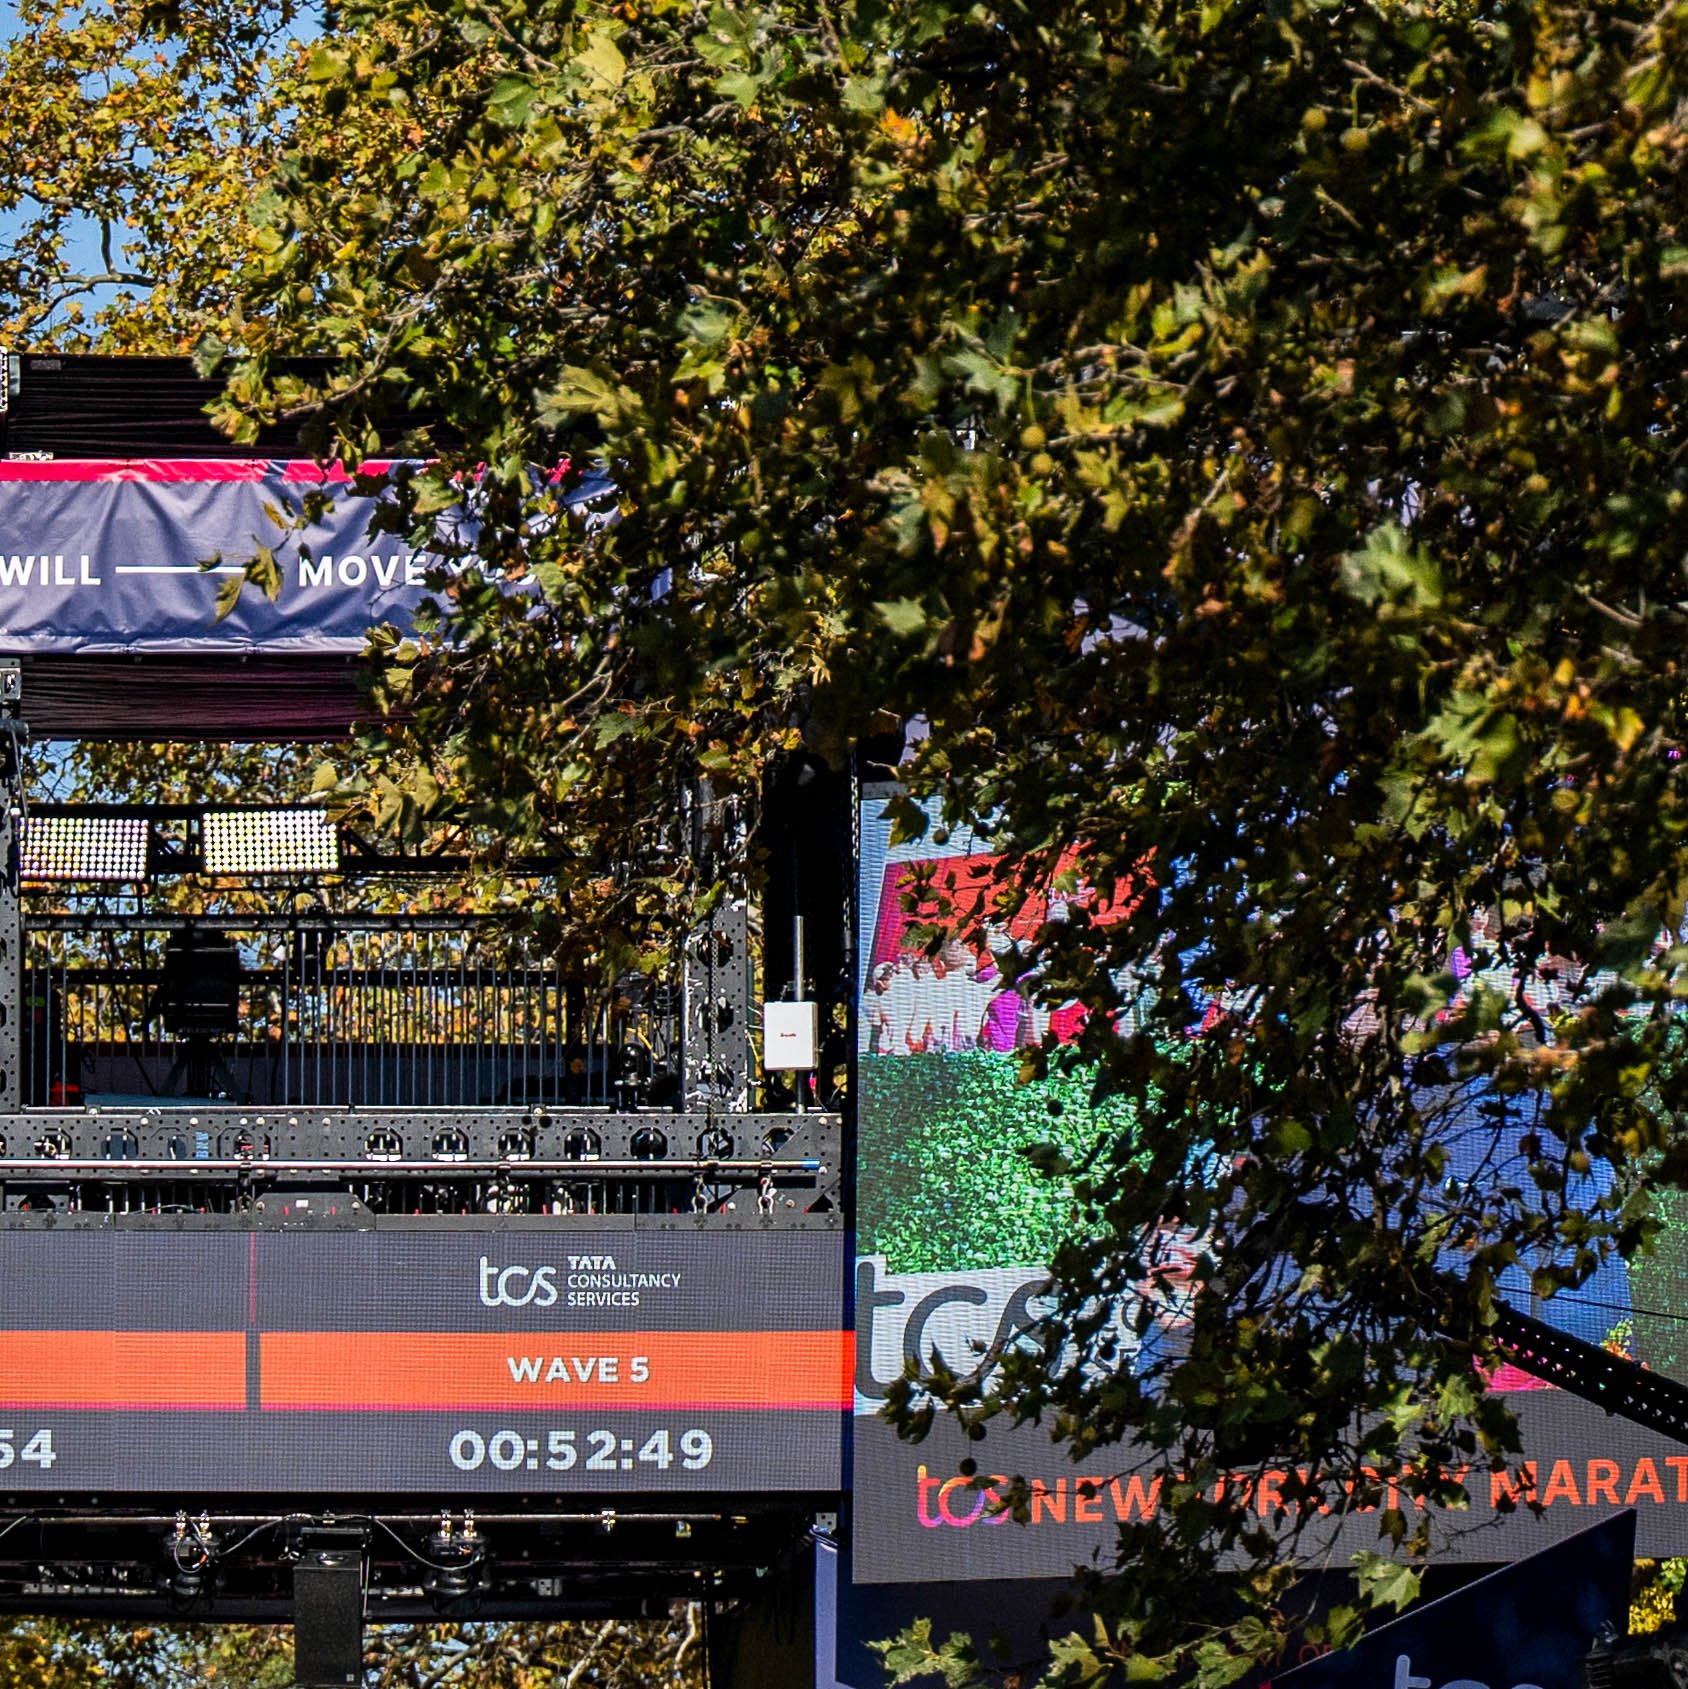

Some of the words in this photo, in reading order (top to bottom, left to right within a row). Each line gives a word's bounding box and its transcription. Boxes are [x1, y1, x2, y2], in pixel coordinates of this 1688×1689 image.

[297, 554, 427, 588] MOVE
[567, 1256, 616, 1270] TATA
[479, 1255, 557, 1308] tcs
[567, 1273, 681, 1290] CONSULTANCY
[567, 1291, 640, 1307] SERVICES
[507, 1357, 619, 1383] WAVE
[629, 1357, 650, 1384] 5
[448, 1430, 713, 1471] 00:52:49
[1031, 1474, 1164, 1525] NEW
